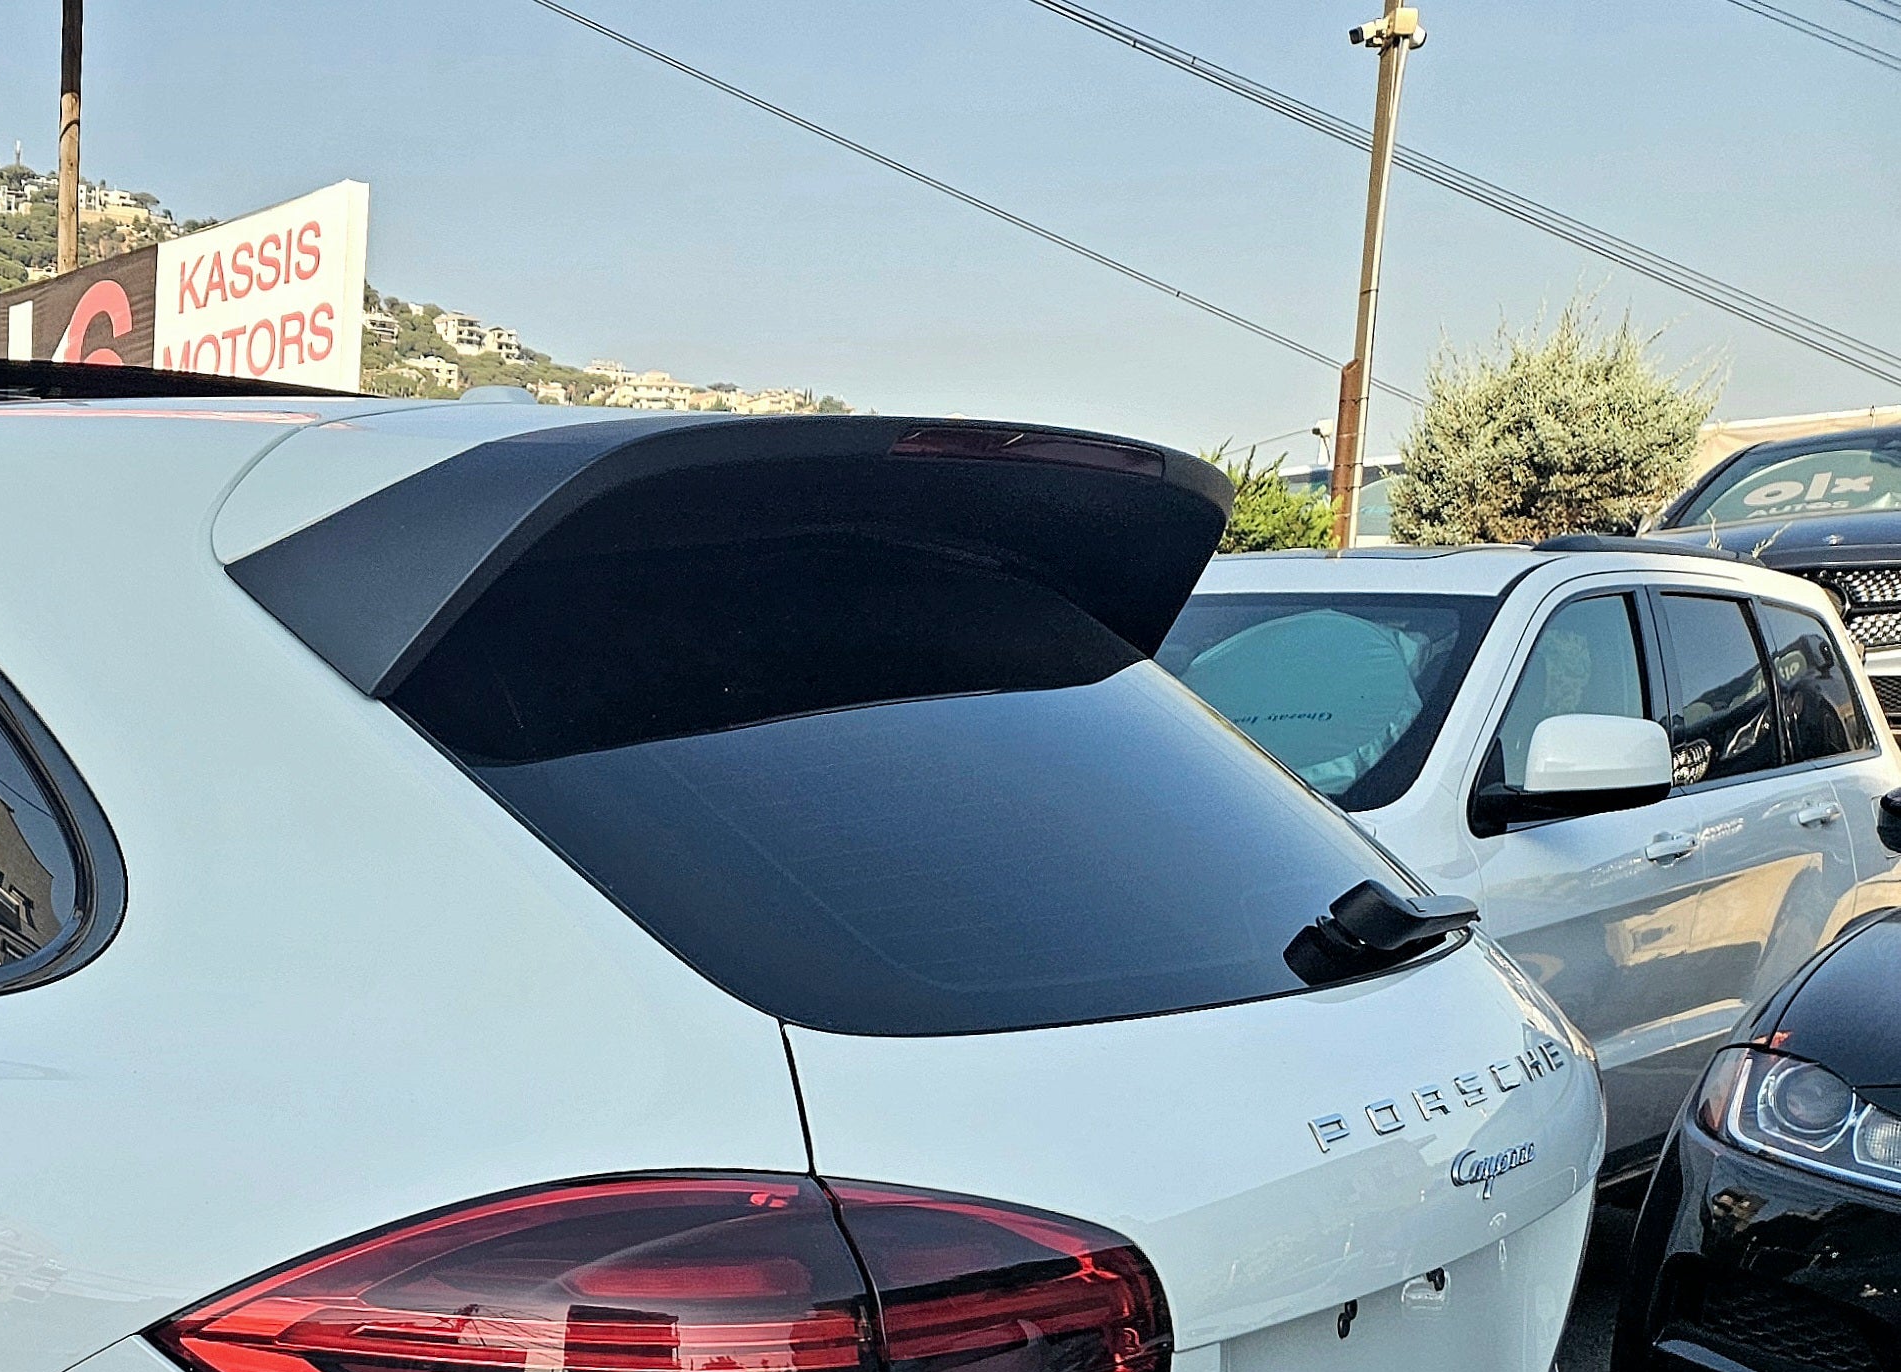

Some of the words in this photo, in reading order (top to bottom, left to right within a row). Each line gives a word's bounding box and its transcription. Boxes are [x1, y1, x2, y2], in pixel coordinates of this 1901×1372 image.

[178, 220, 322, 315] KASSIS
[1744, 471, 1874, 506] olx
[1307, 1040, 1566, 1154] PORSCHE
